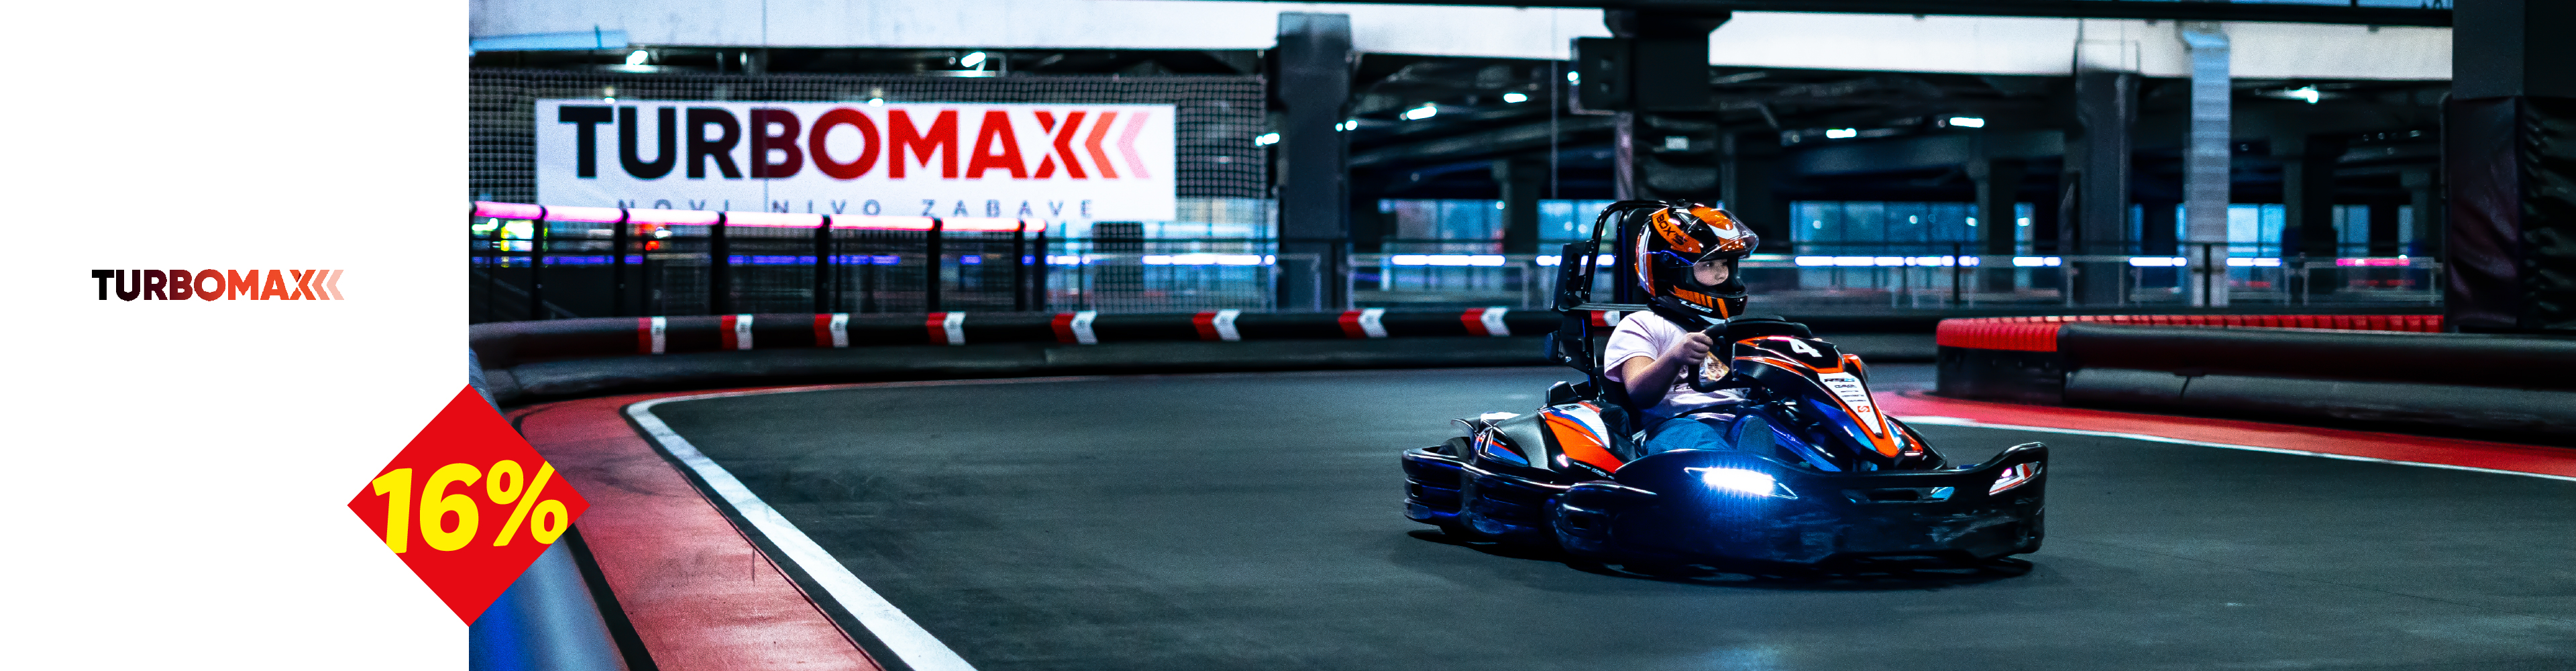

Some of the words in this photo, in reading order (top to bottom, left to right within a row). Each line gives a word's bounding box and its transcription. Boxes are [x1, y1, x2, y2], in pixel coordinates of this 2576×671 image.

[559, 105, 1088, 180] TURBOMAX
[772, 199, 881, 215] NIVO
[922, 199, 1092, 217] ZABAVE
[1789, 338, 1823, 358] 4
